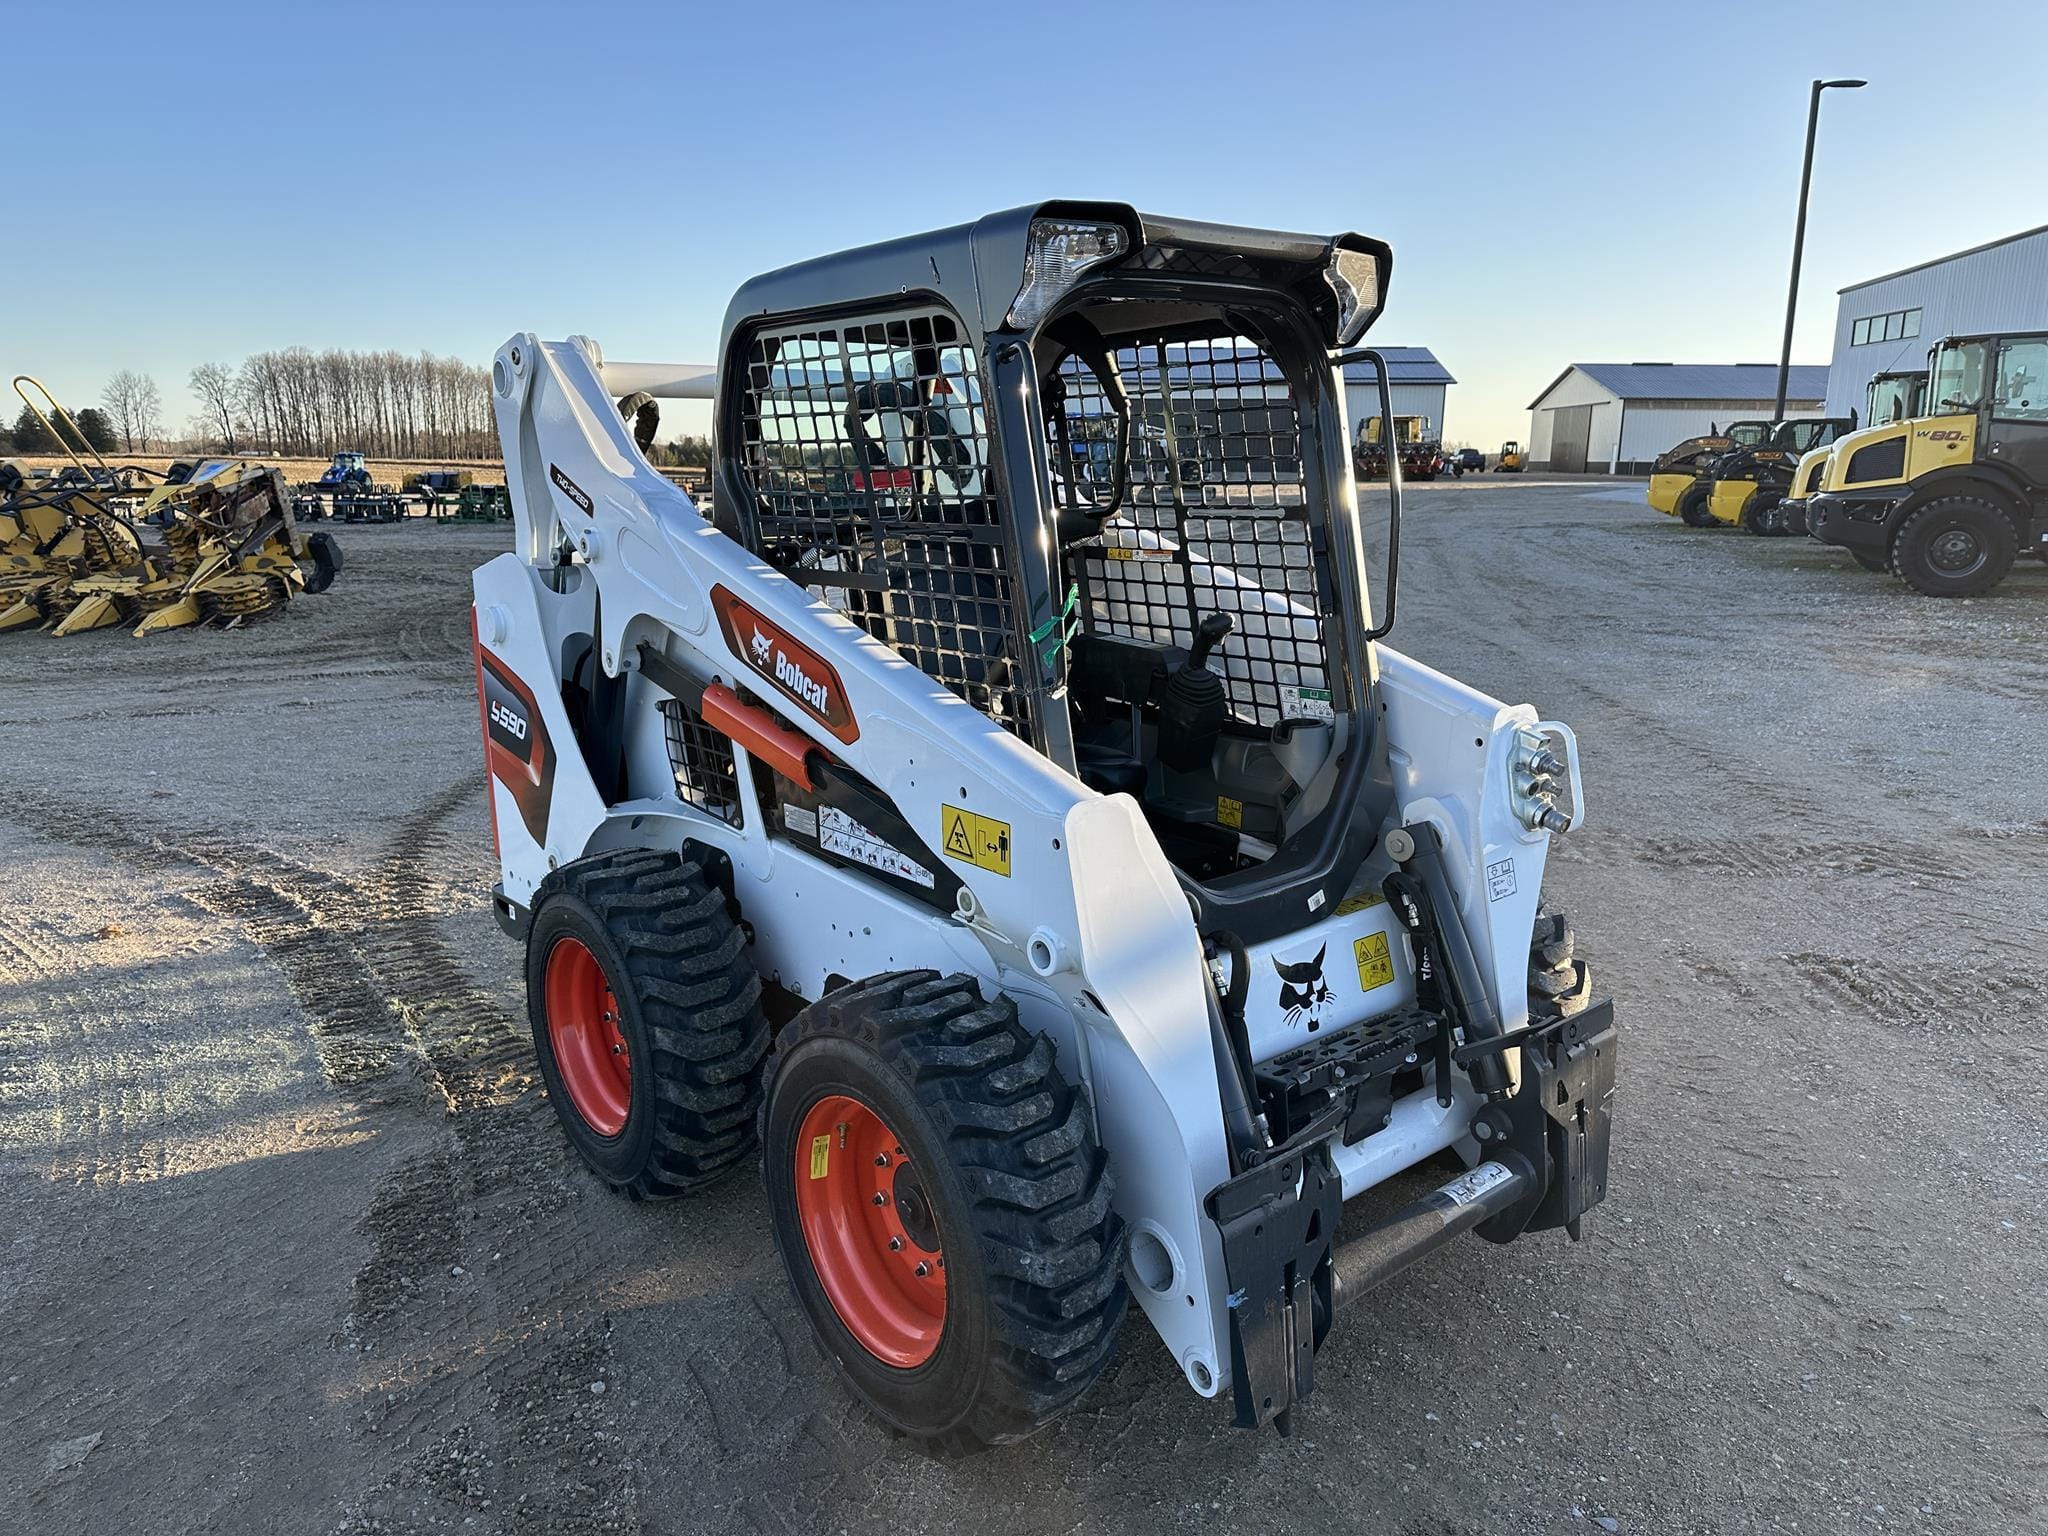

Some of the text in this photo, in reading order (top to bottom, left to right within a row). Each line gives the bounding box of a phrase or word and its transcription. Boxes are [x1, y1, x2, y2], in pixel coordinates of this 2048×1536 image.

[556, 473, 589, 508] TWO-SPEED
[775, 649, 828, 714] Bobcat
[490, 700, 527, 740] S590
